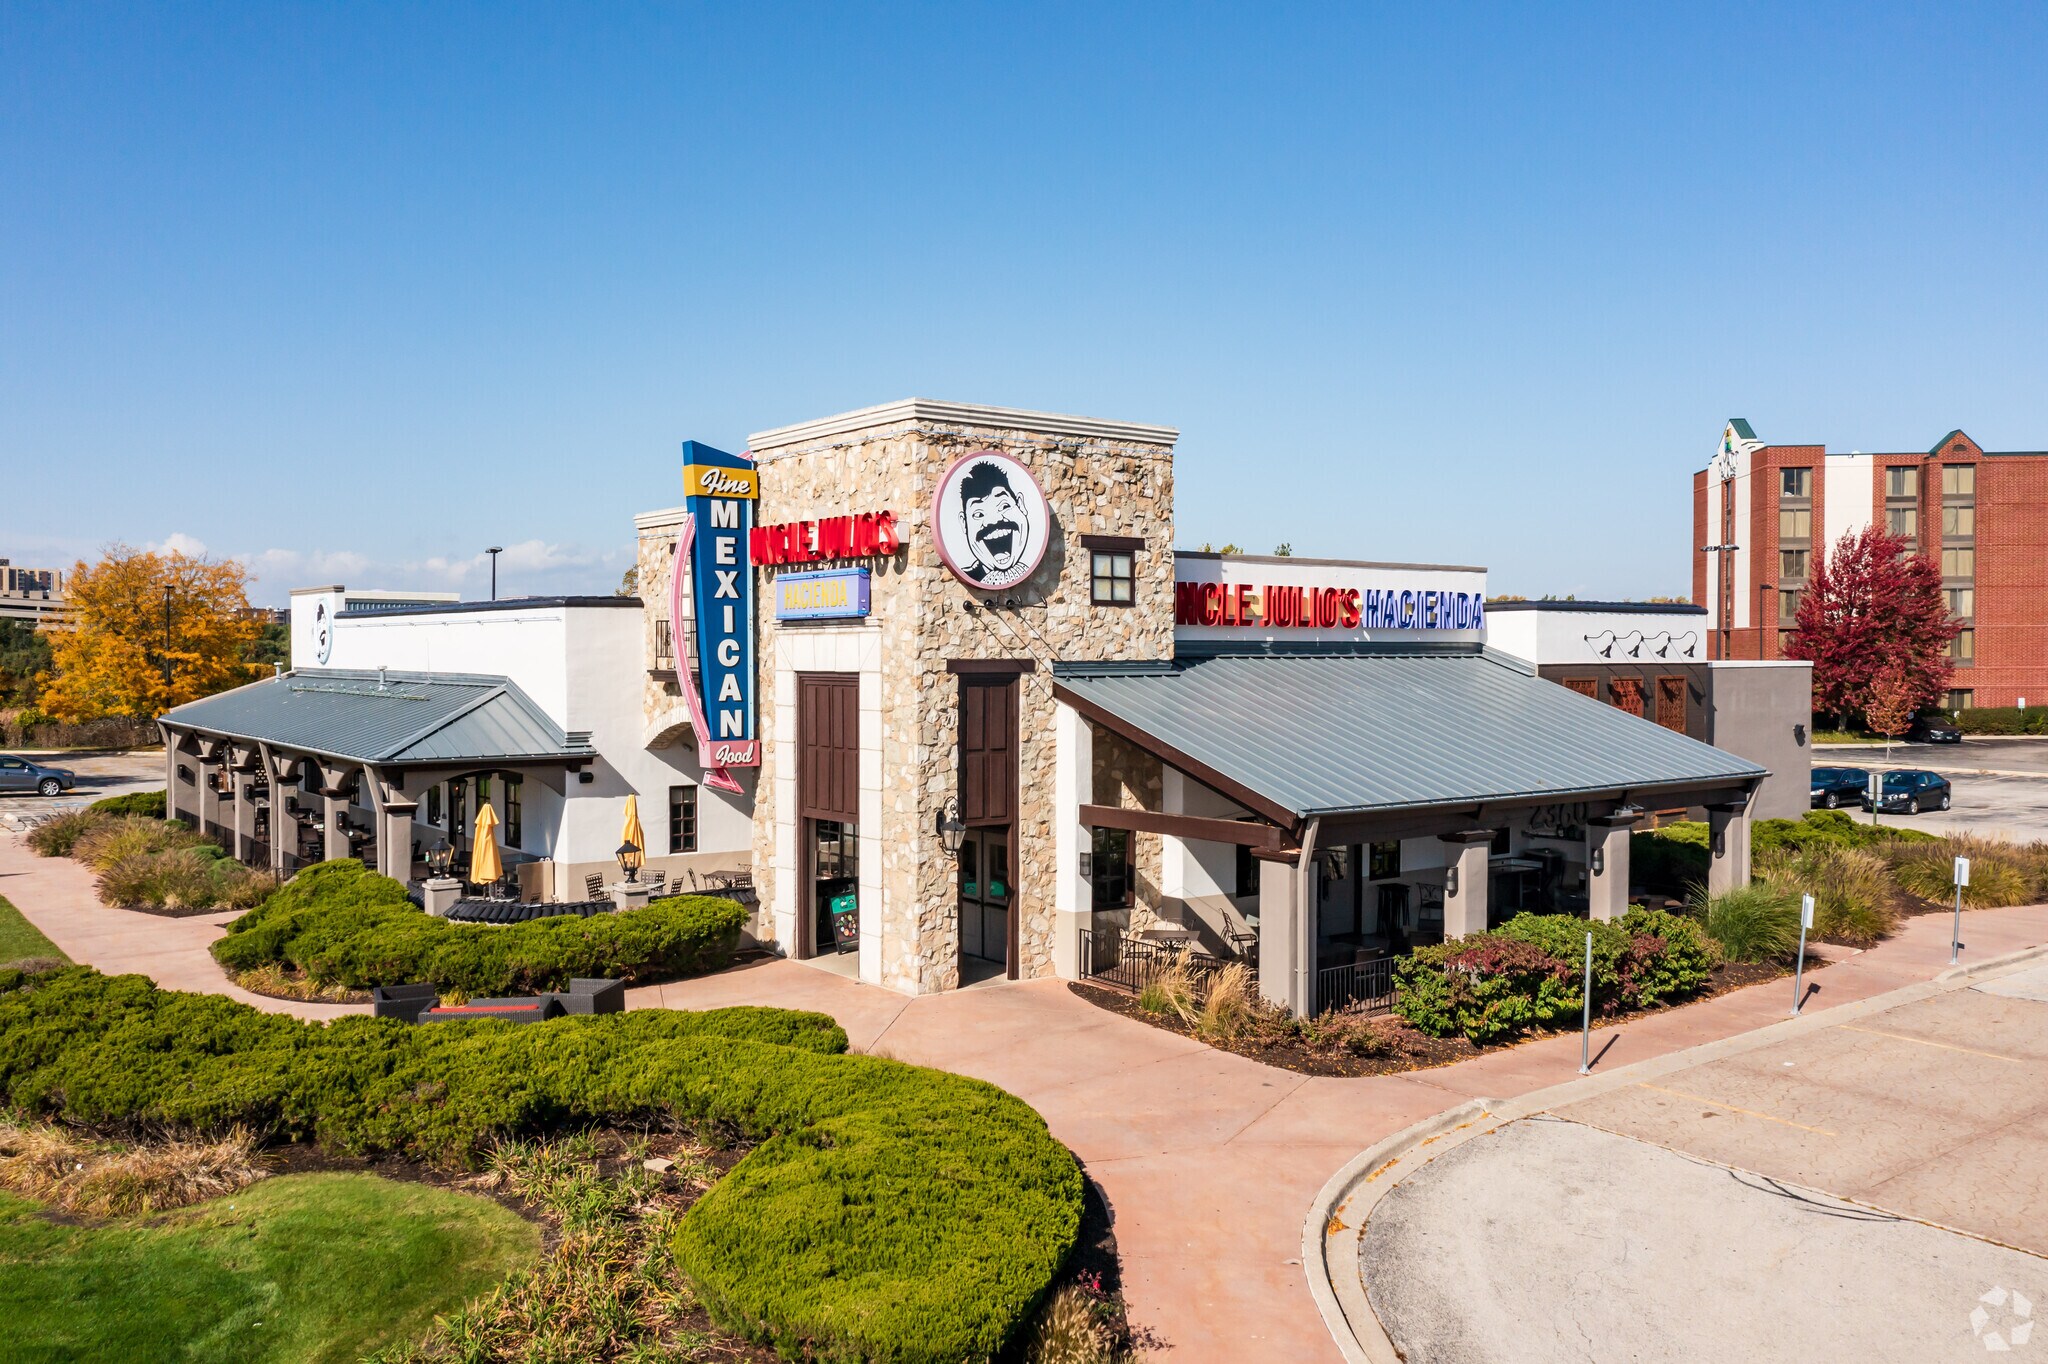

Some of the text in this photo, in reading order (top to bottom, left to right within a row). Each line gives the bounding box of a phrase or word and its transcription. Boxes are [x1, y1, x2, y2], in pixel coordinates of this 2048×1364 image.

[700, 468, 751, 494] Fine
[784, 579, 848, 610] HACIENDA
[1174, 581, 1484, 631] NCLE JULIO'S HACIENDA
[710, 499, 743, 738] MEXICAN
[715, 742, 754, 766] Food
